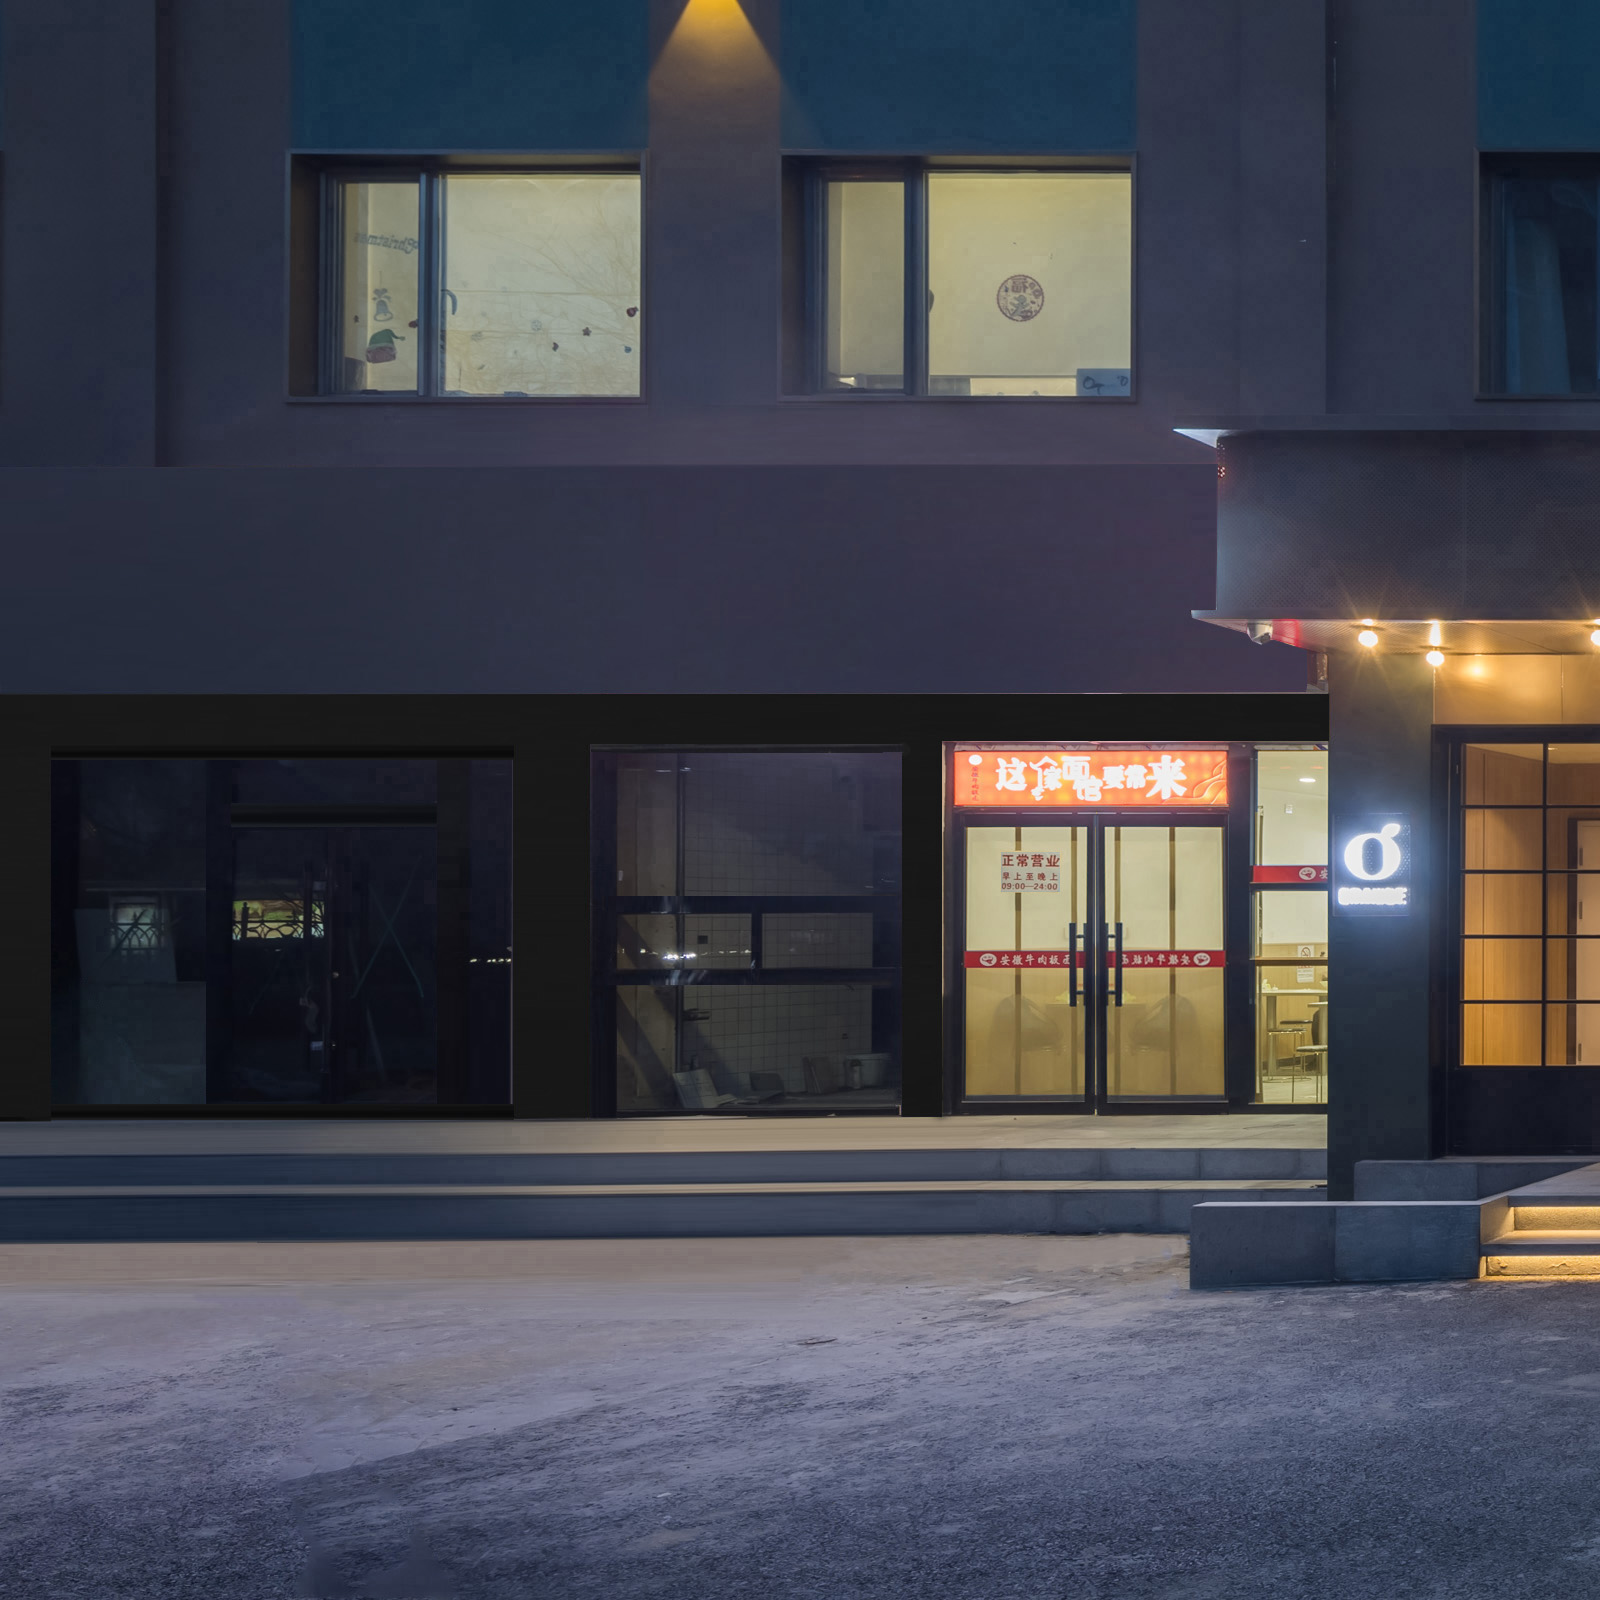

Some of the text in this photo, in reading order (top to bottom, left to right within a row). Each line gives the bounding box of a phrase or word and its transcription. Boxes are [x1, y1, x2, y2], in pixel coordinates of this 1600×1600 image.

[1002, 853, 1060, 868] 正常营业
[1002, 871, 1059, 882] 早上至晚上
